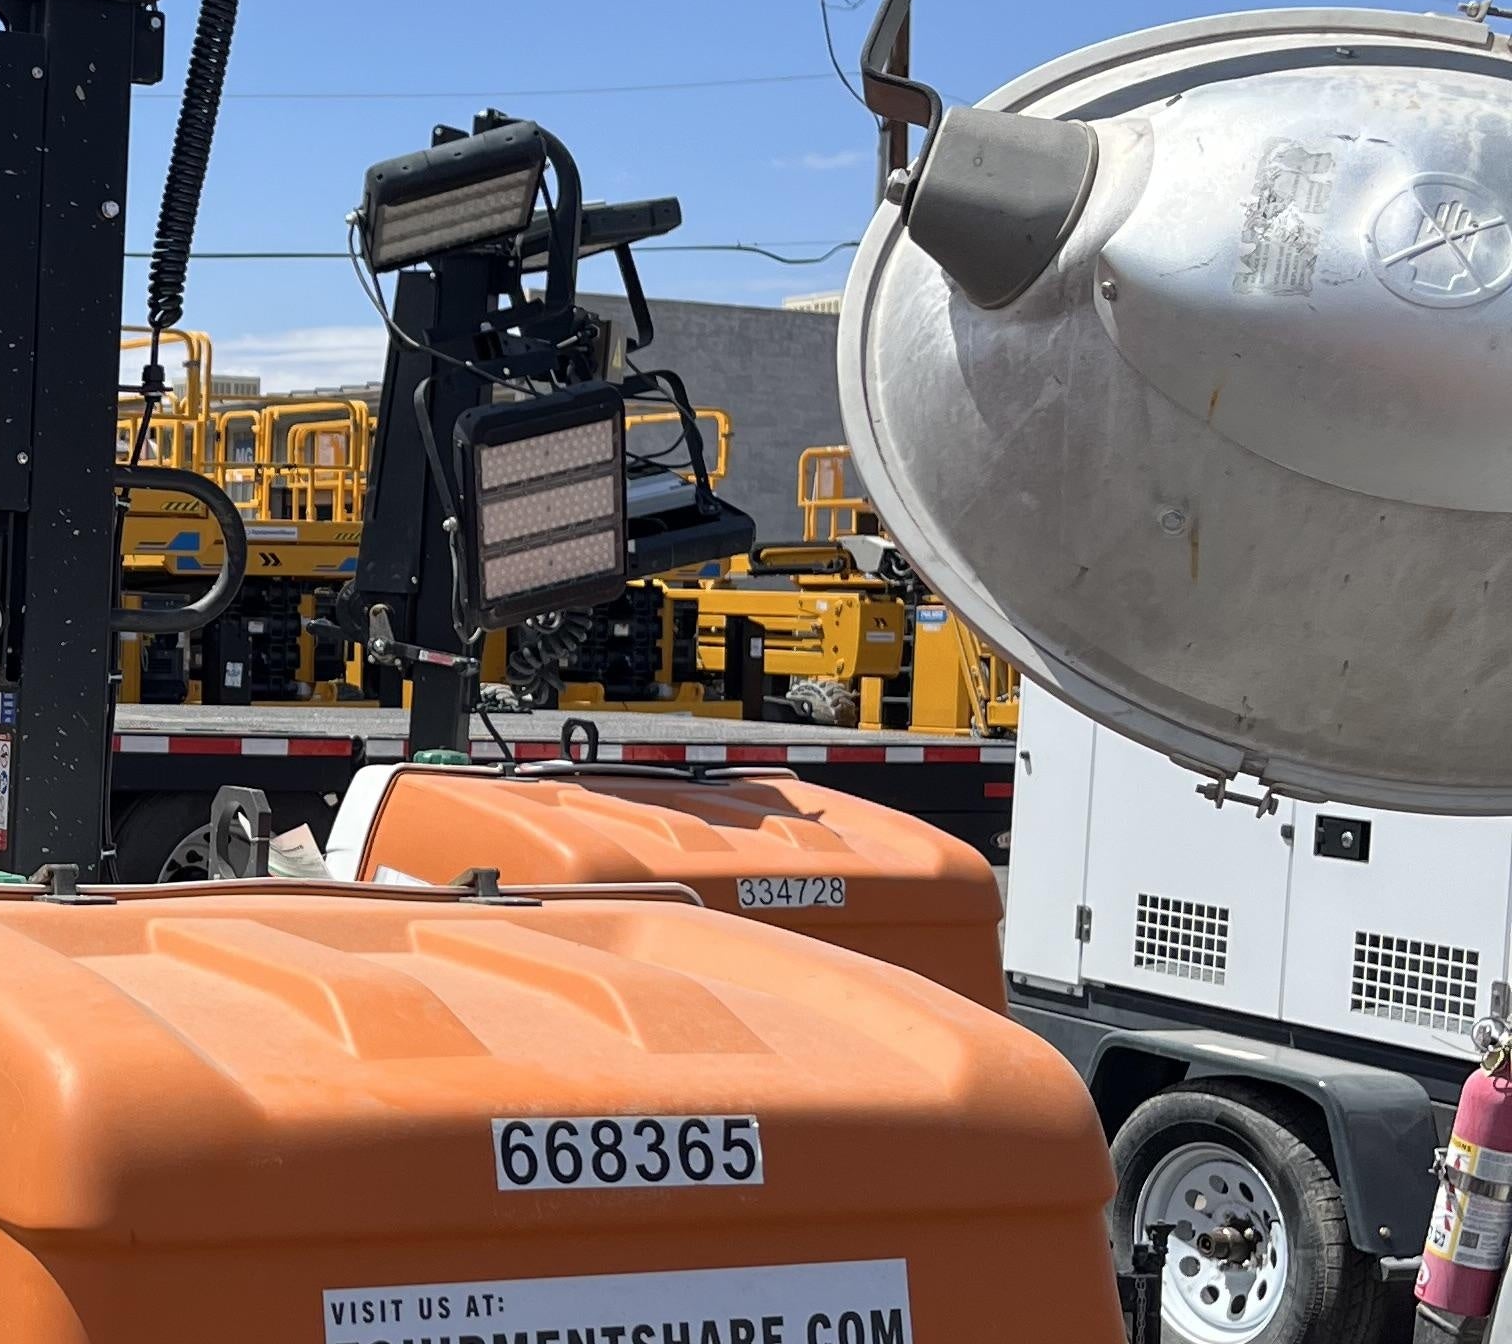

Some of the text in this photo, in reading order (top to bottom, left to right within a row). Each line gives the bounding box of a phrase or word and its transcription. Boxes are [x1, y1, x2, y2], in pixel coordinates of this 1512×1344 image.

[740, 878, 844, 906] 334728
[500, 1118, 758, 1186] 668365
[331, 1293, 506, 1325] VISIT US AT:
